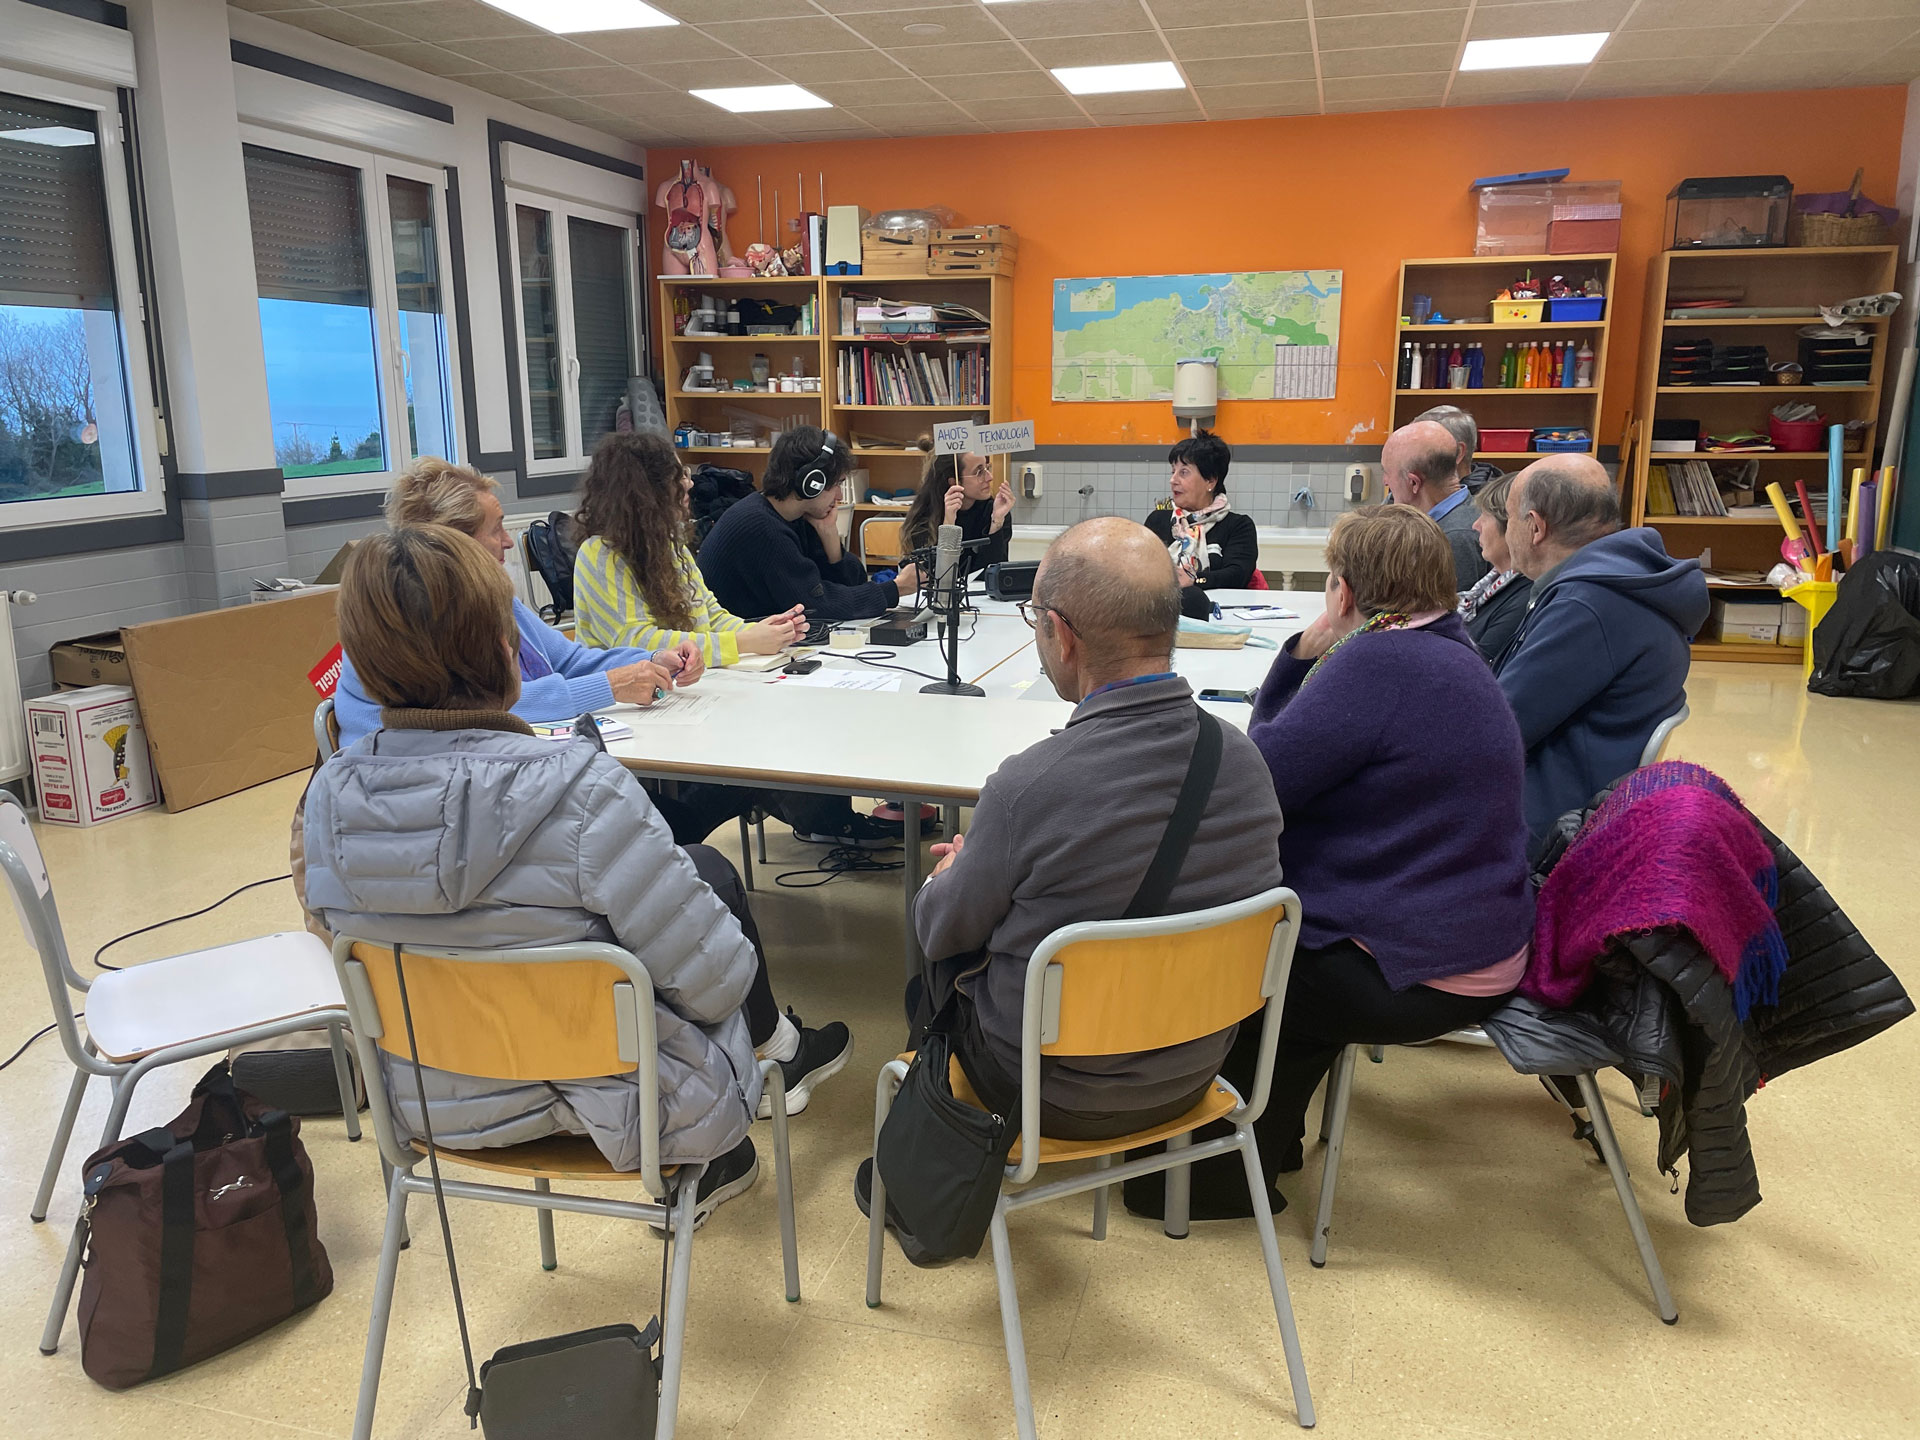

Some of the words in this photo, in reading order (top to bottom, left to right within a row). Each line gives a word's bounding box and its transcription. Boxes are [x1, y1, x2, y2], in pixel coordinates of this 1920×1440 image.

[937, 426, 969, 441] AHOTS
[978, 426, 1030, 444] TEKNOLOGIA
[945, 441, 966, 450] VOZ
[315, 659, 343, 692] RAGIL
